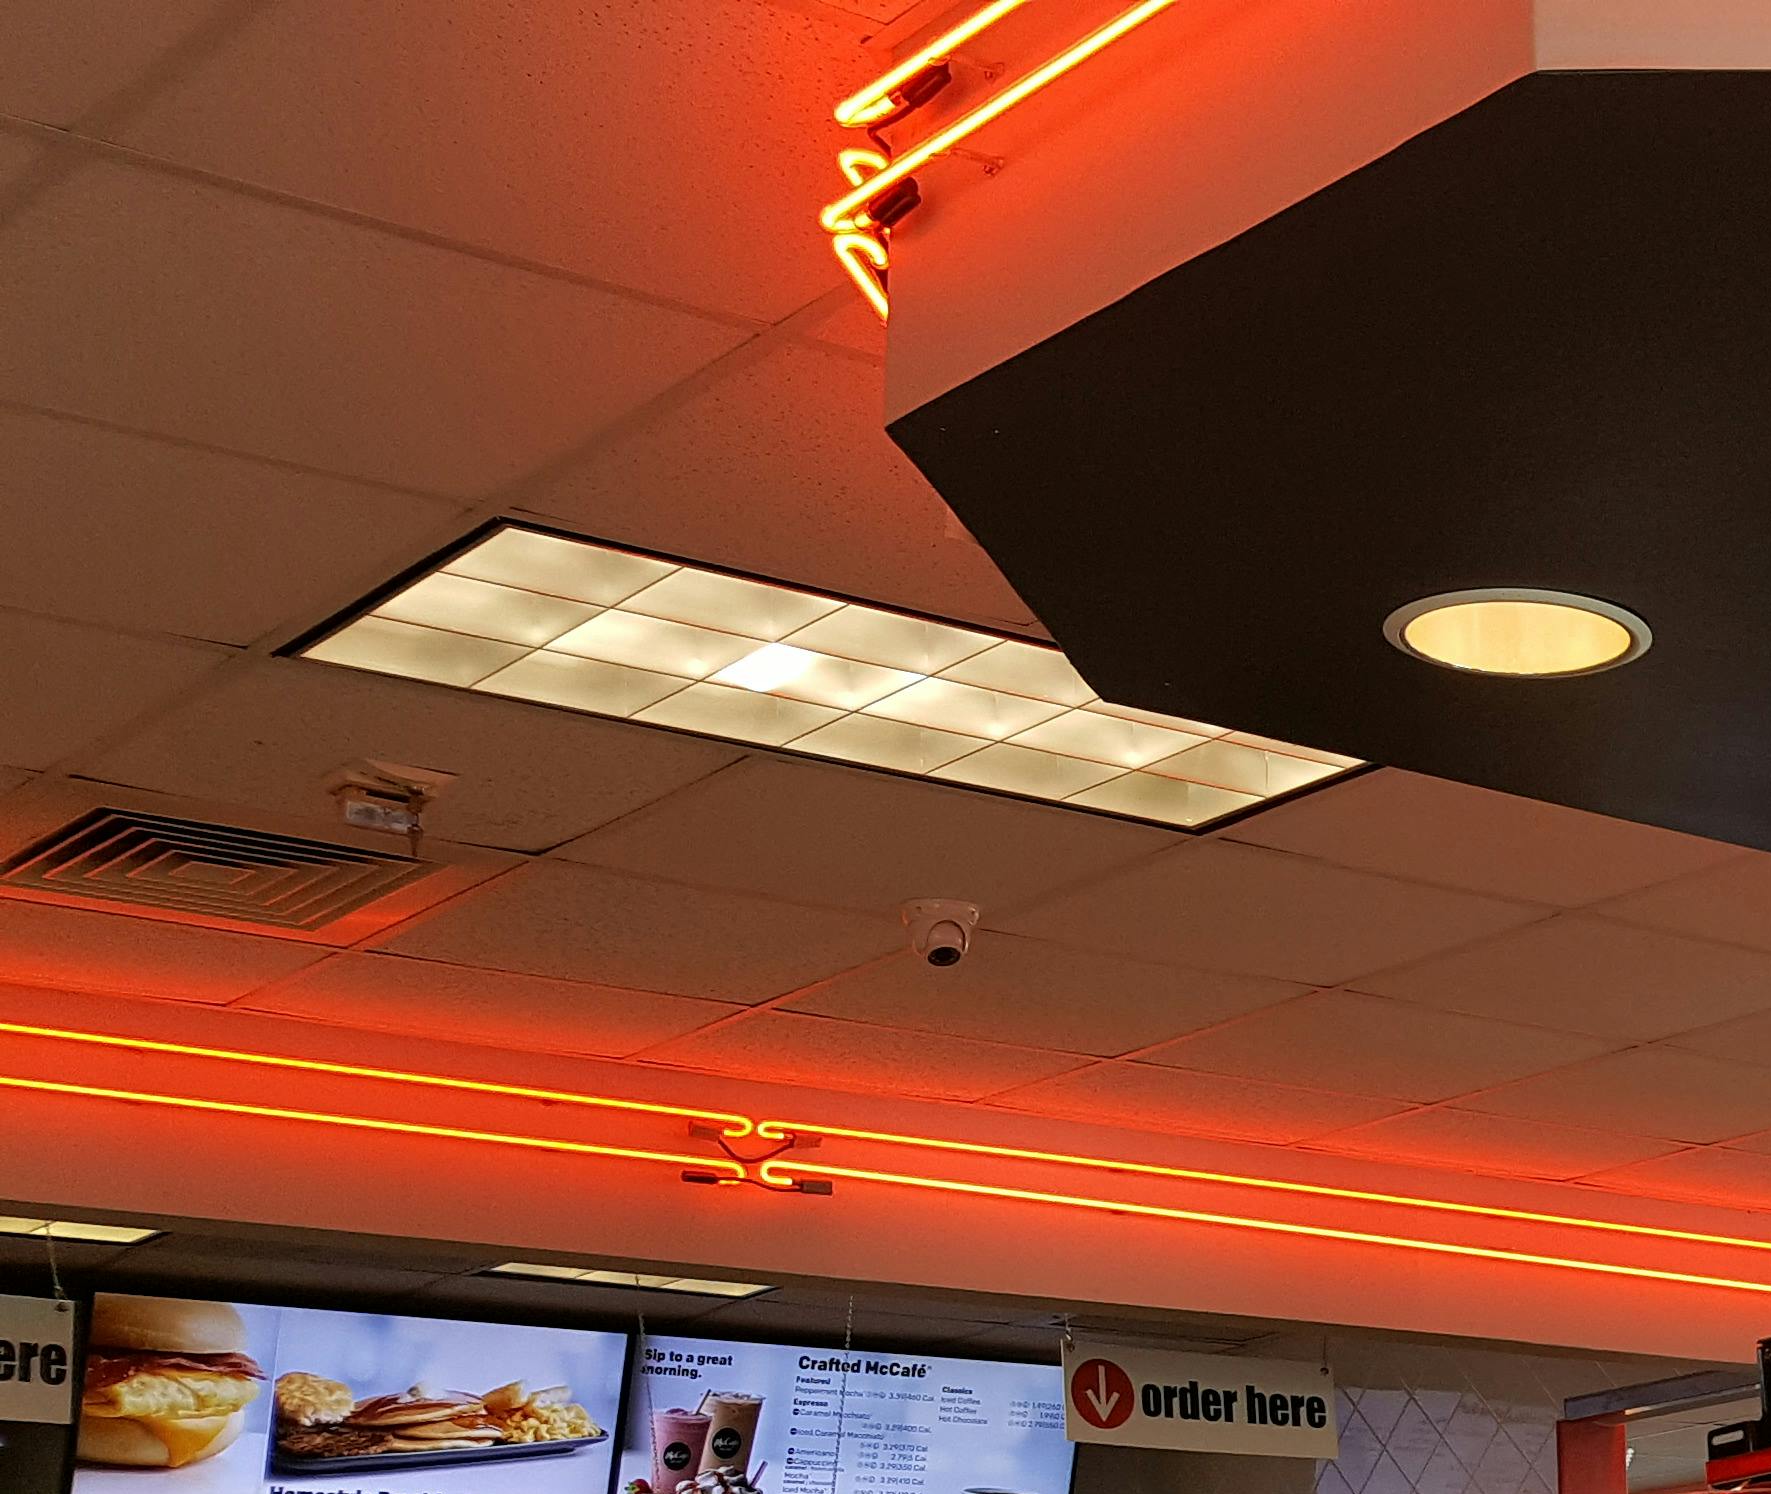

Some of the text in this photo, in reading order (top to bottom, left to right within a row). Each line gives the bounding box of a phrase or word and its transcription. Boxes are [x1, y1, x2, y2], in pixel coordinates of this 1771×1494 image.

[644, 1348, 733, 1367] Sip to a great
[798, 1355, 862, 1373] Crafted
[1142, 1379, 1327, 1429] order here
